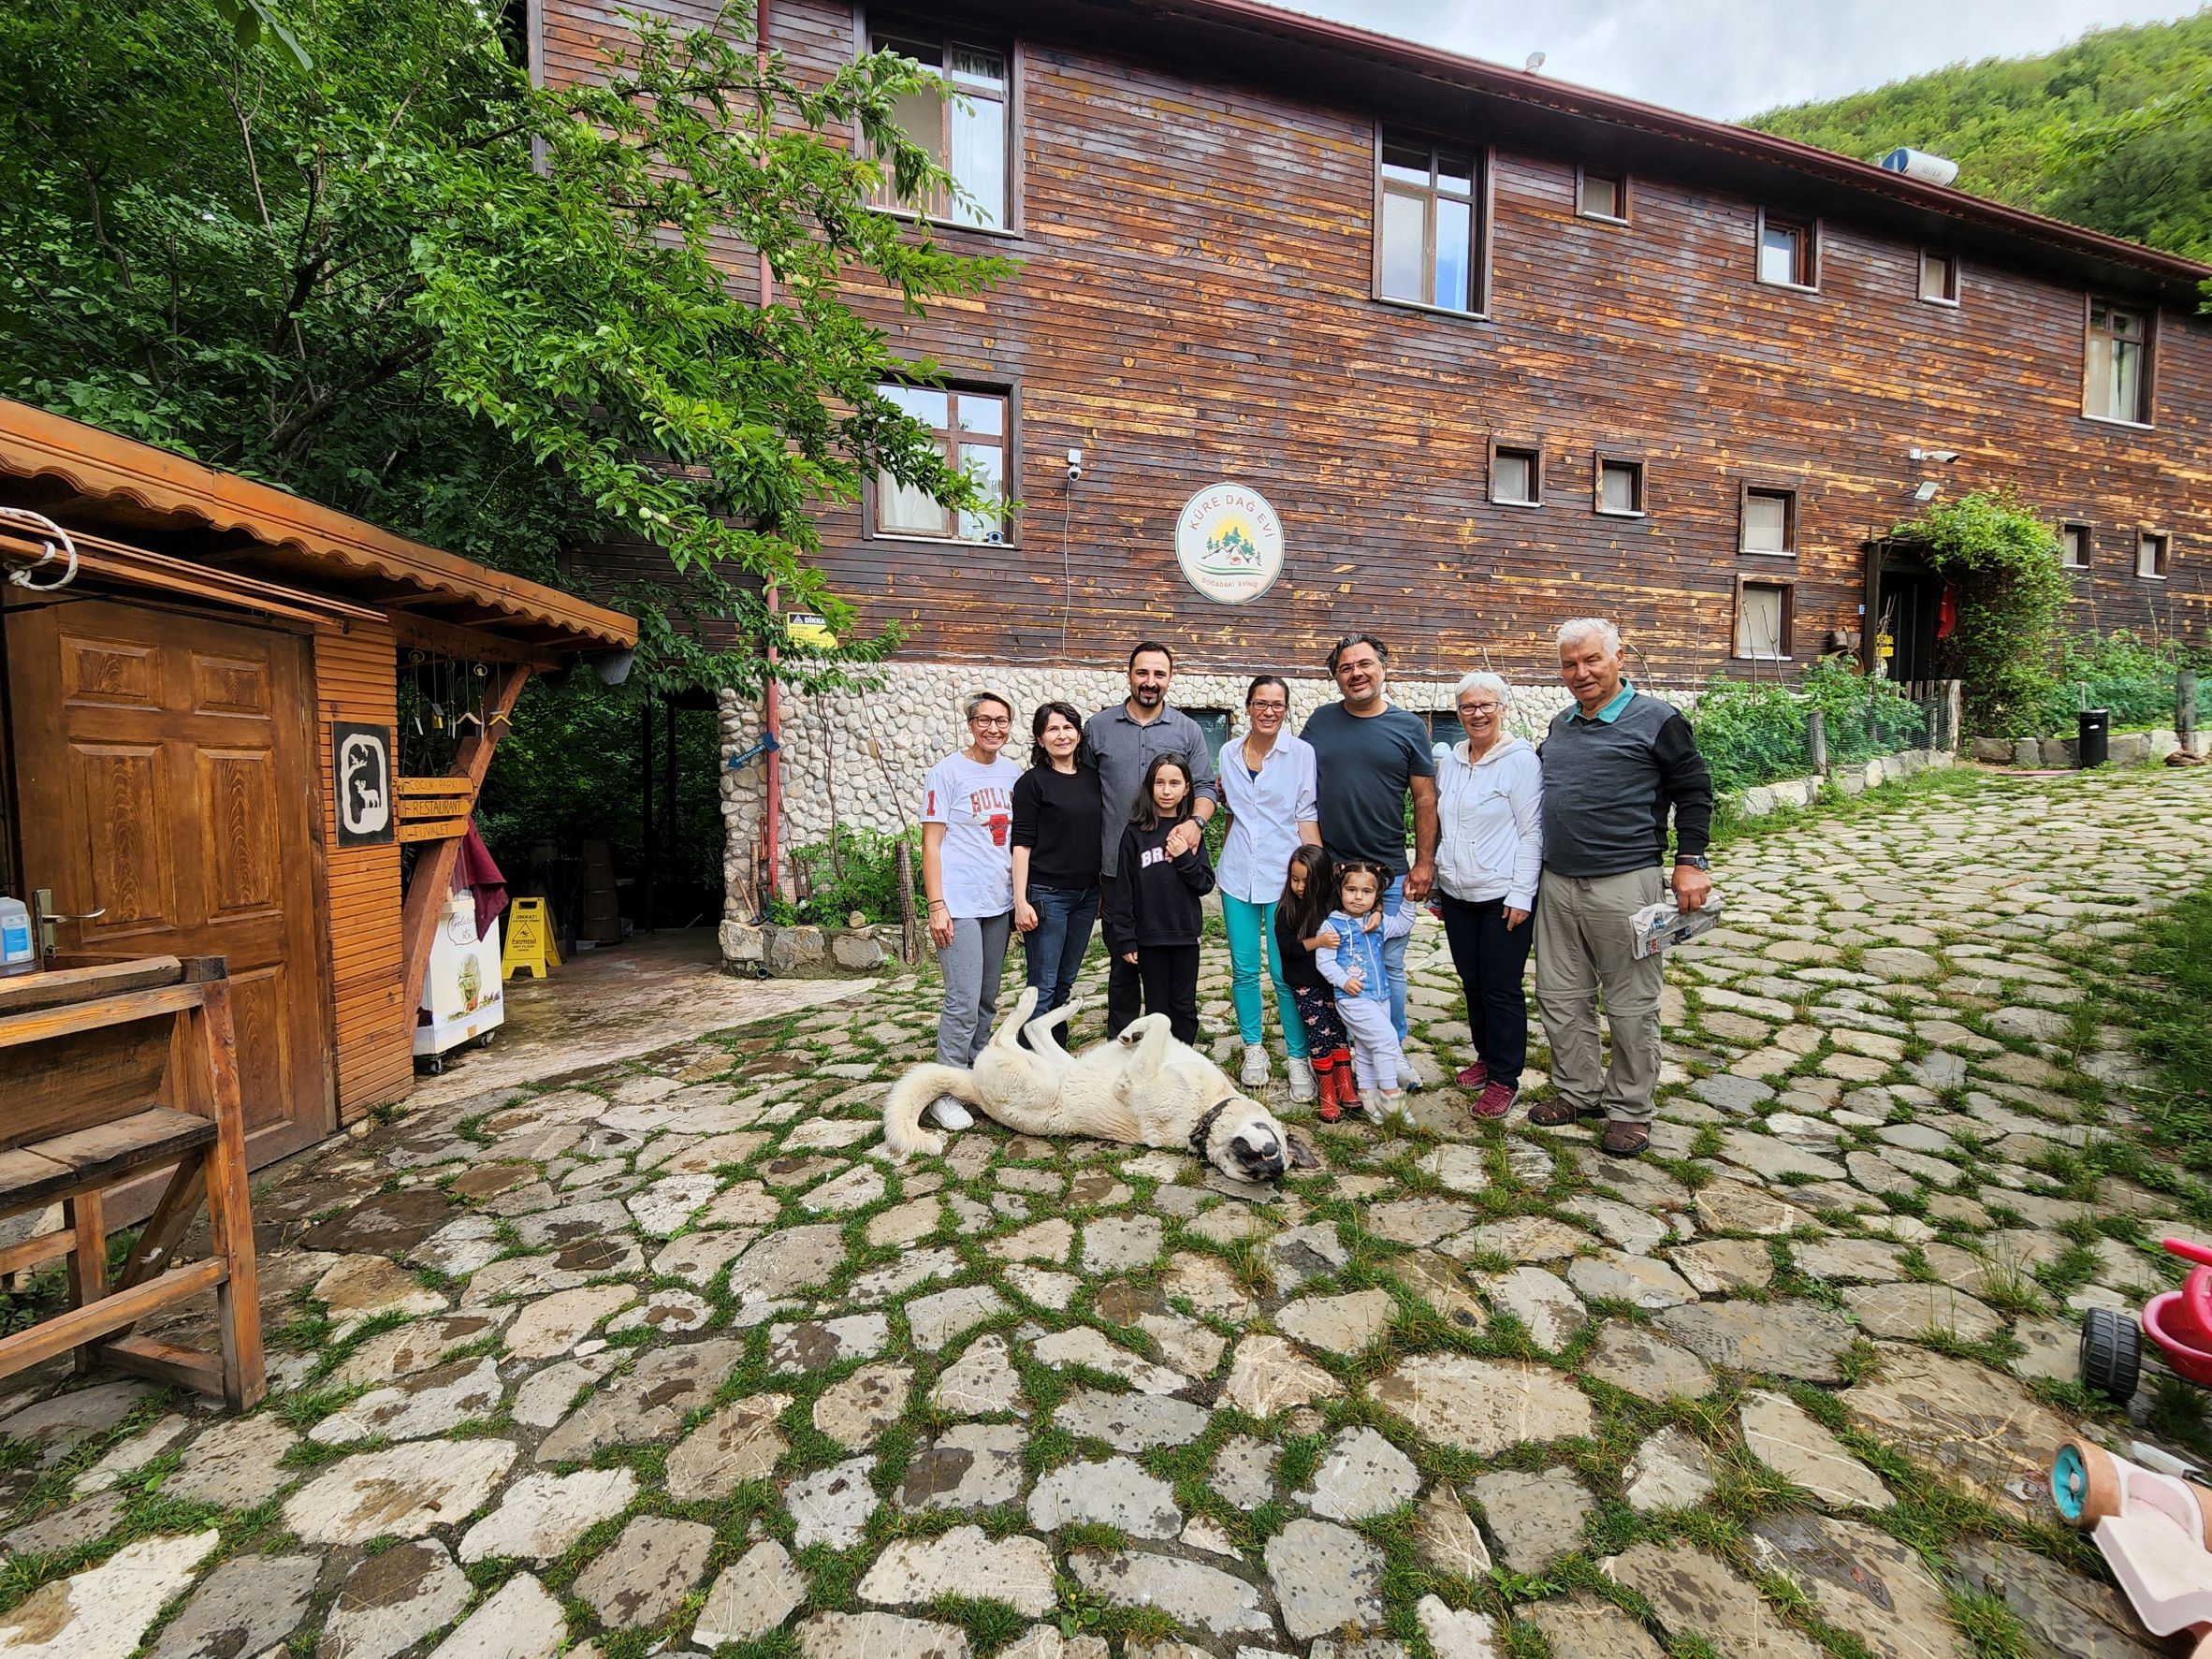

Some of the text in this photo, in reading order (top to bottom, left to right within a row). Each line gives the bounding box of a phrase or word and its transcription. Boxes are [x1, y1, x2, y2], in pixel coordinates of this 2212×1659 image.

[1188, 494, 1276, 538] KÜRE DAĞ EVİ
[804, 616, 826, 624] DİKKA
[413, 800, 462, 816] RESTAURANT
[412, 823, 449, 838] TUVALET
[1141, 846, 1171, 868] BR
